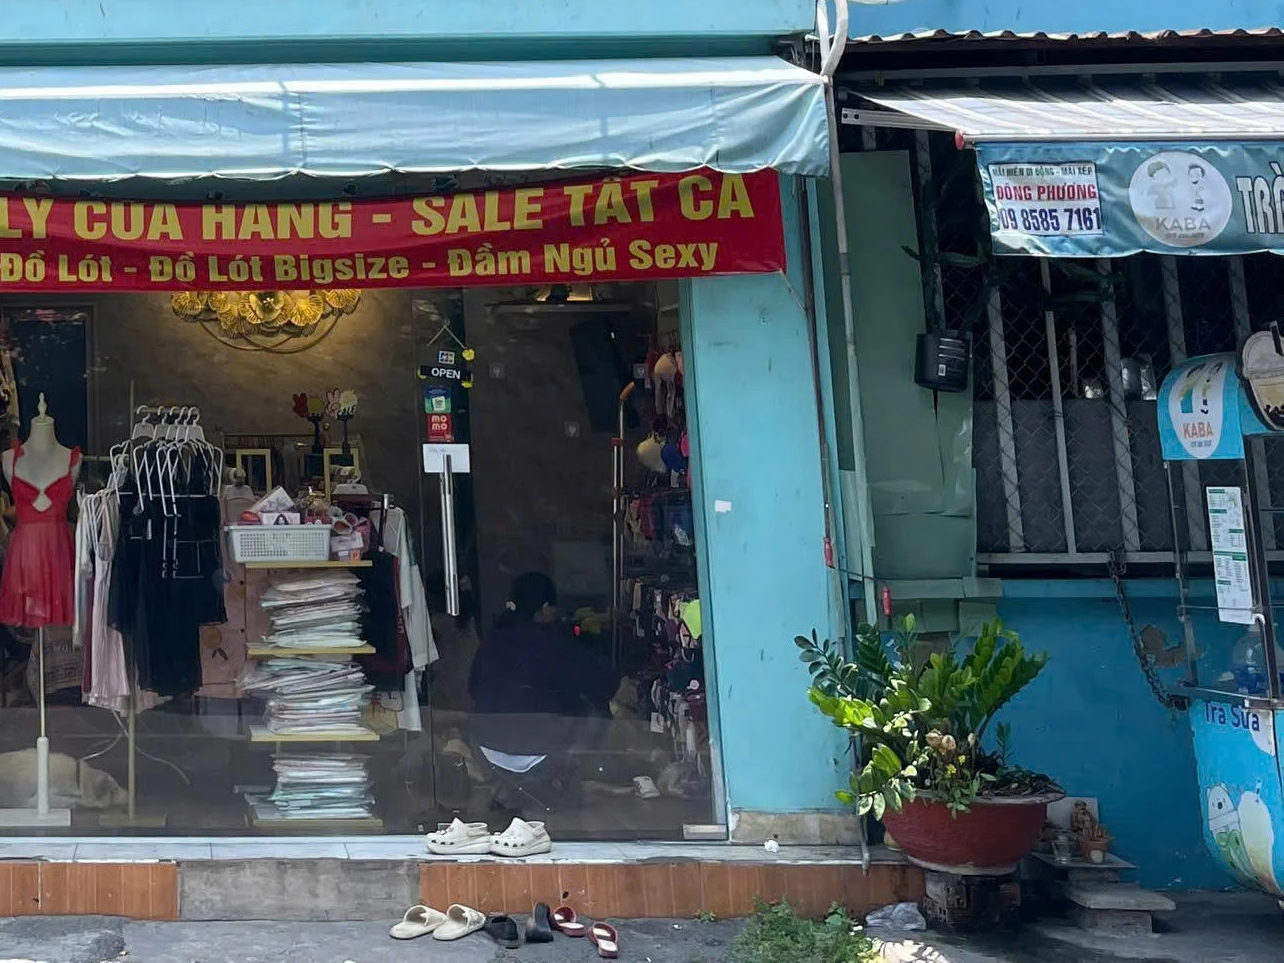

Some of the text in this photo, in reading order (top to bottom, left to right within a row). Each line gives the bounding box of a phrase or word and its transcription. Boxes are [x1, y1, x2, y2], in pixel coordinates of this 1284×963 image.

[996, 182, 1097, 201] ĐÔNG PHƯƠNG
[412, 186, 545, 236] SALE
[999, 207, 1101, 232] 09 8585 7161
[1156, 217, 1212, 231] KABA
[58, 252, 114, 283] Lót
[149, 250, 196, 282] Đồ
[209, 251, 264, 283] Lót
[275, 253, 410, 286] Bigsize
[447, 241, 531, 277] Đầm
[544, 237, 617, 276] Ngủ
[629, 239, 719, 271] Sexy
[431, 367, 461, 379] OPEN
[1183, 421, 1213, 439] KABA
